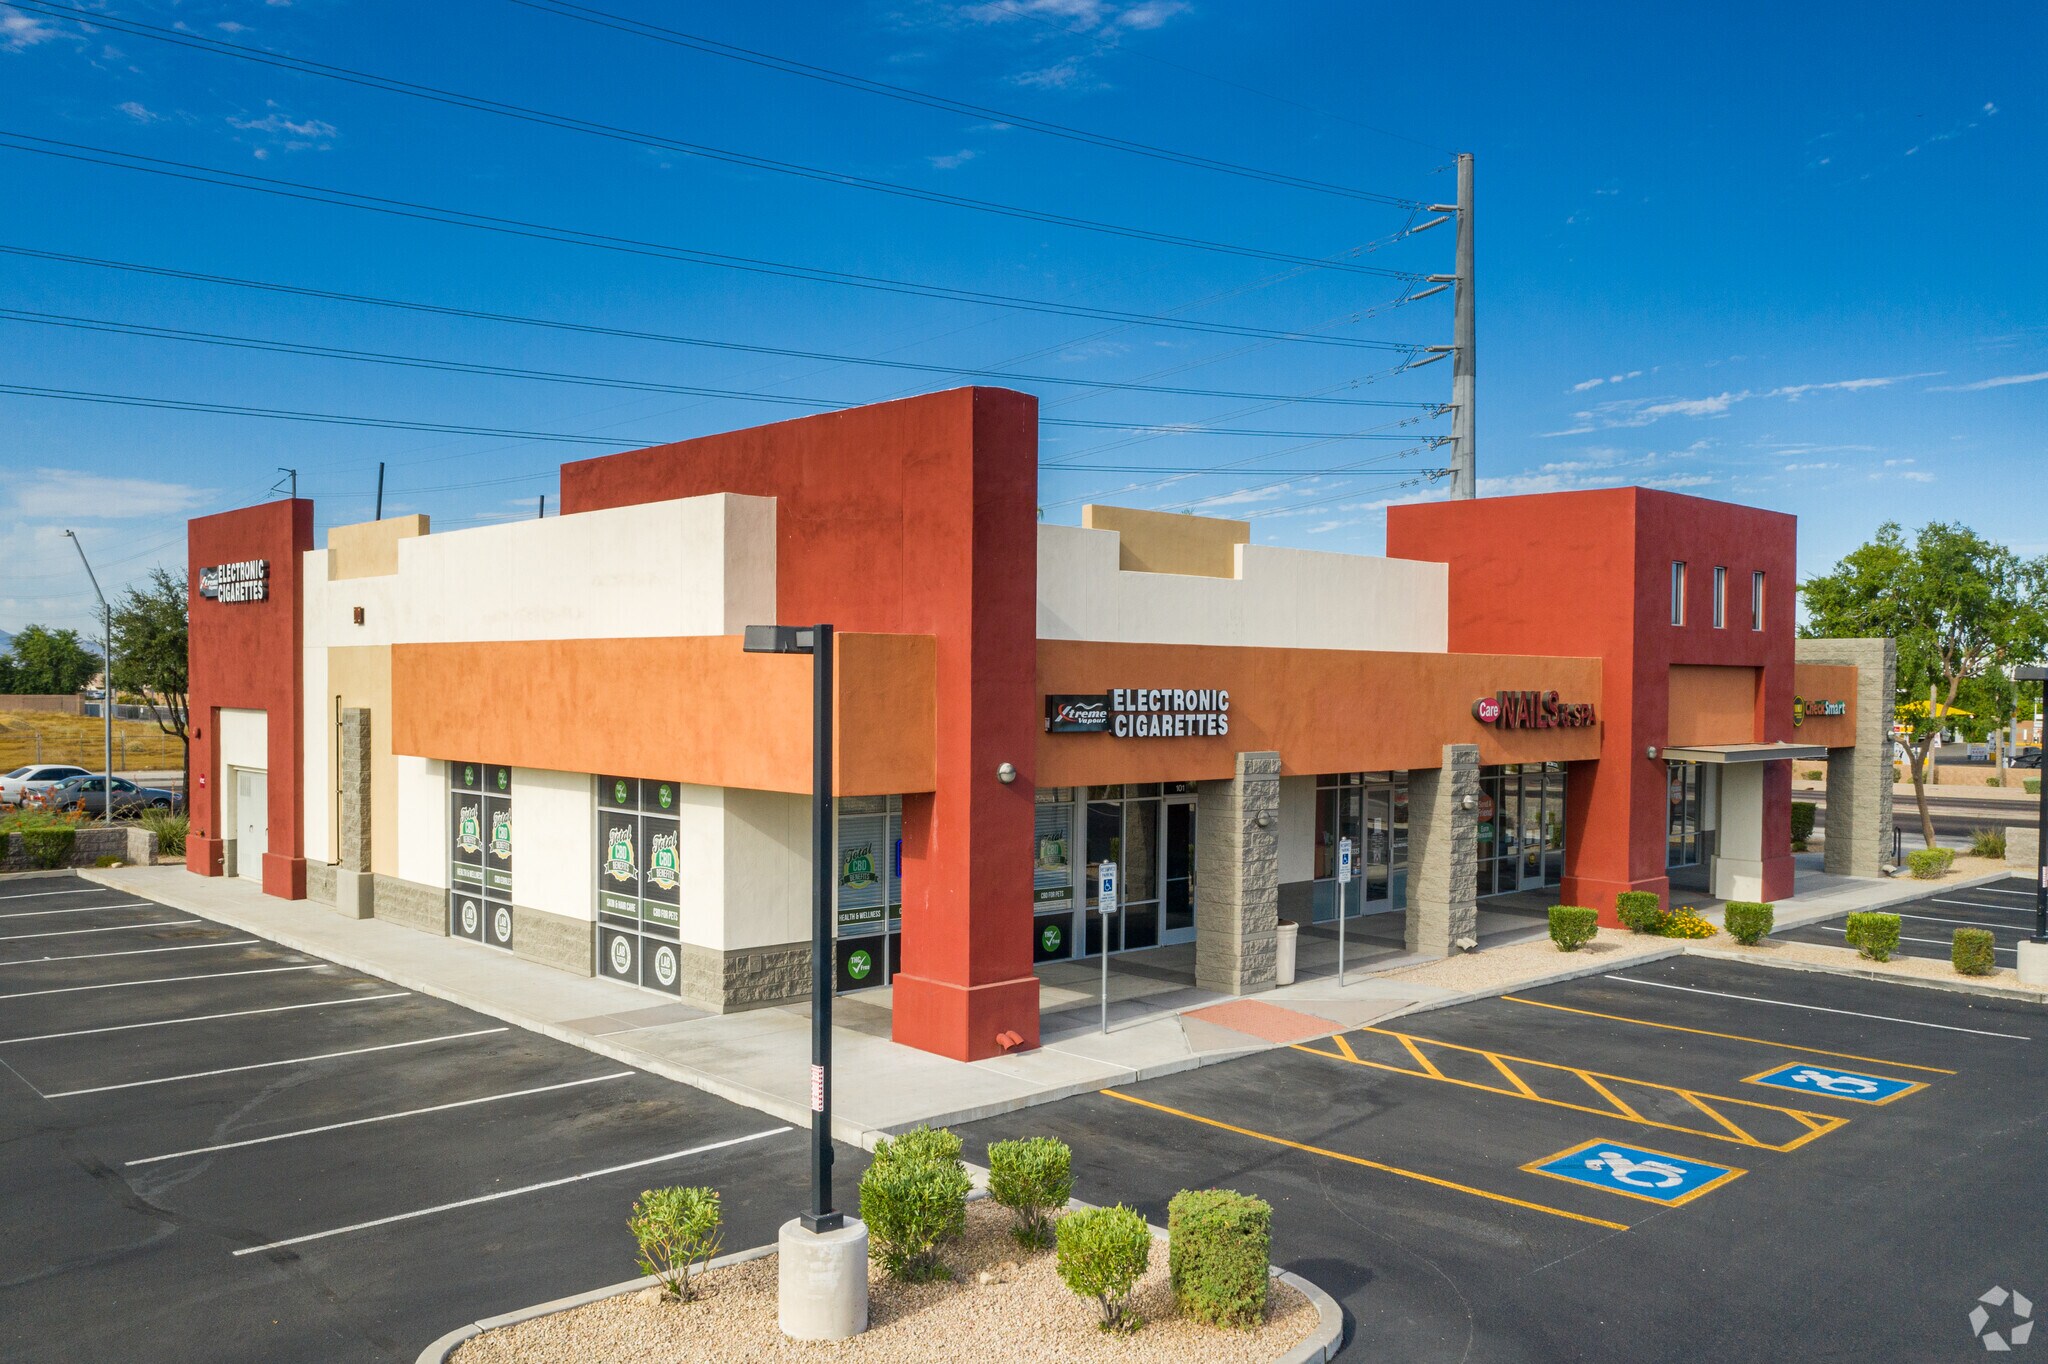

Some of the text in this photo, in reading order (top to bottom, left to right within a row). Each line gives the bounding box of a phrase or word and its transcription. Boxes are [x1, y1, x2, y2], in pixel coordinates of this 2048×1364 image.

[218, 559, 264, 583] ELECTRONIC
[218, 580, 263, 602] CIGARETTES
[1113, 688, 1229, 711] ELECTRONIC
[1055, 704, 1107, 722] Xtreme
[1480, 702, 1498, 717] Care
[1500, 690, 1597, 729] NAILS & SPA
[1805, 700, 1846, 715] CheckSmart
[1115, 714, 1228, 737] CIGARETTES
[609, 824, 632, 846] Total
[652, 830, 677, 853] Total
[615, 846, 627, 860] CBD
[659, 851, 673, 867] CBD
[846, 843, 872, 864] Total
[853, 860, 867, 872] CBD
[656, 868, 675, 880] BENEFITS
[668, 910, 678, 921] PETS
[839, 909, 881, 921] HEALTH & WELLNESS
[616, 945, 626, 957] LAB
[660, 955, 671, 968] LAB
[851, 956, 862, 964] THC
